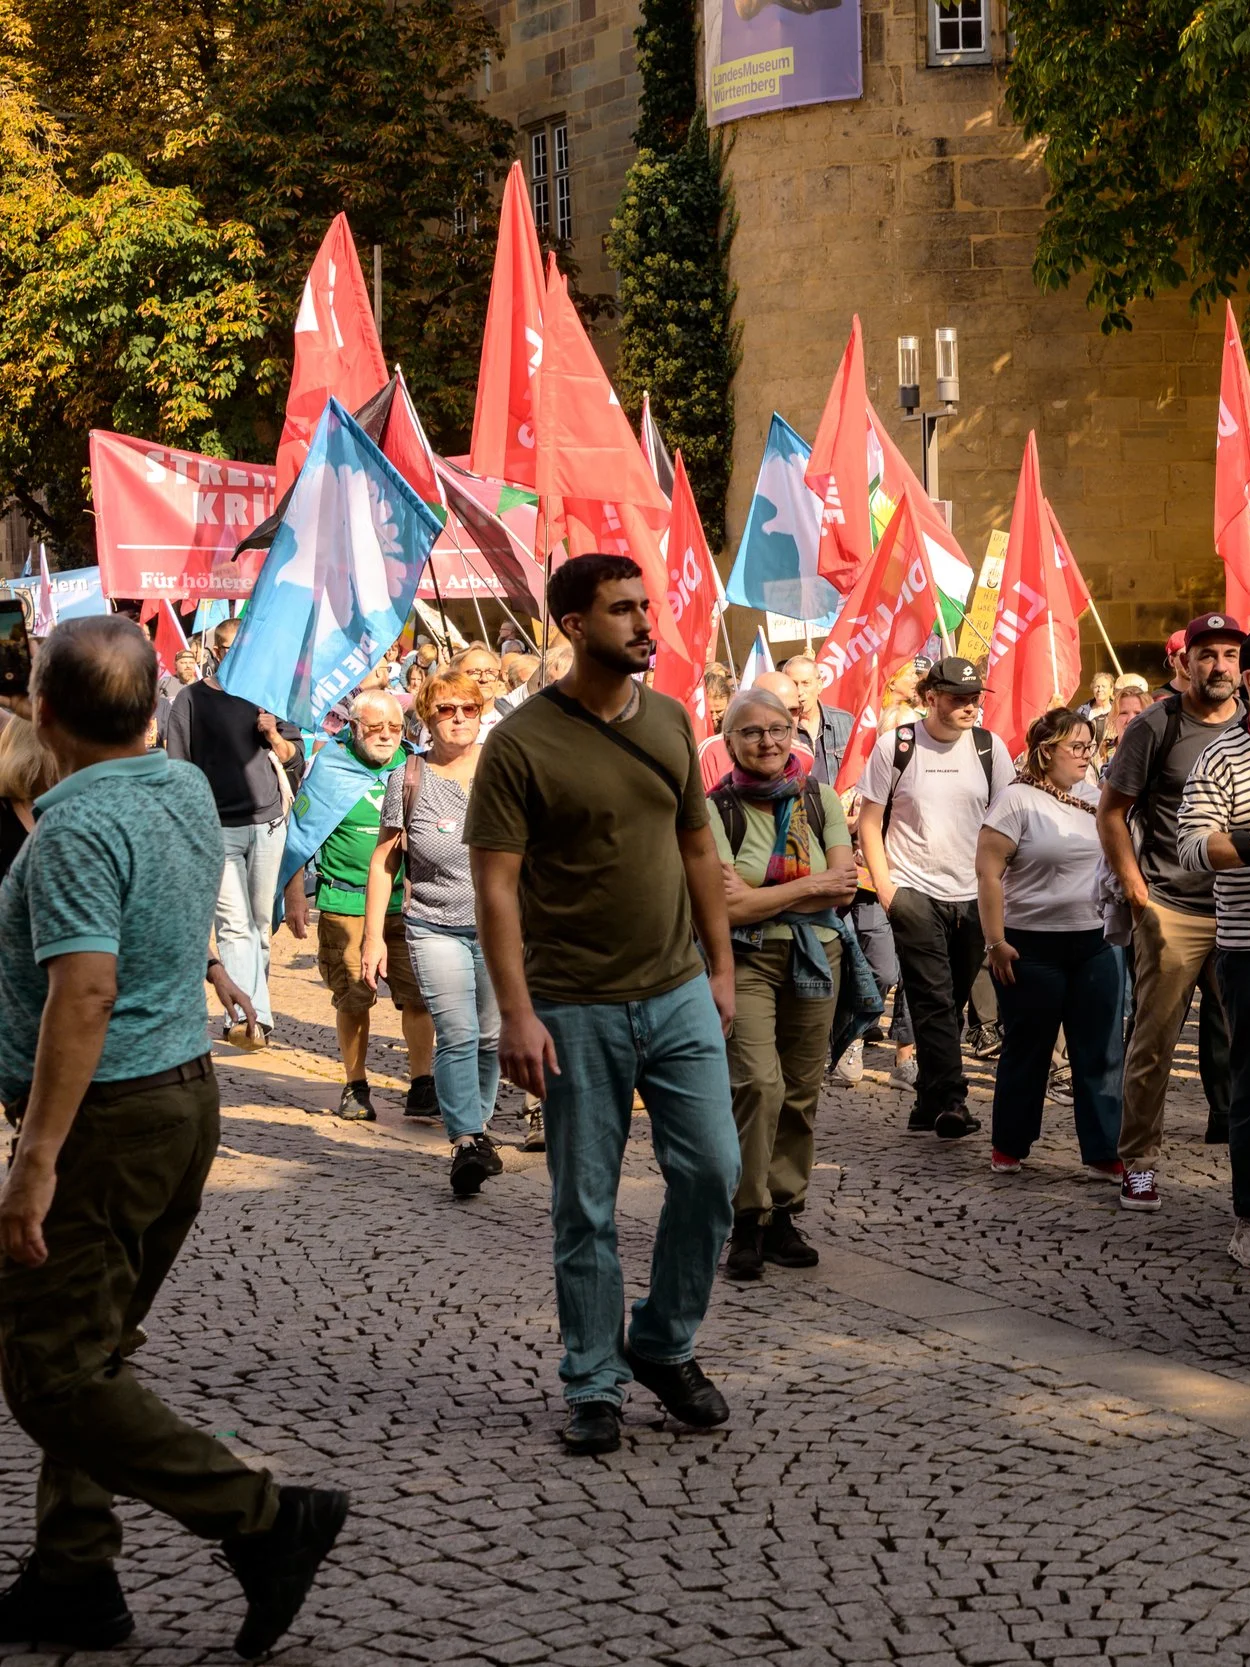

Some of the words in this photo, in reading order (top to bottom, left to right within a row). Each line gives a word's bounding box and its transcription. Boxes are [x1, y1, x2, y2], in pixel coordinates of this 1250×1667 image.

[713, 56, 790, 87] LandesMuseum
[713, 77, 776, 104] Württemberg
[140, 571, 178, 589] Für
[181, 572, 254, 590] höhere
